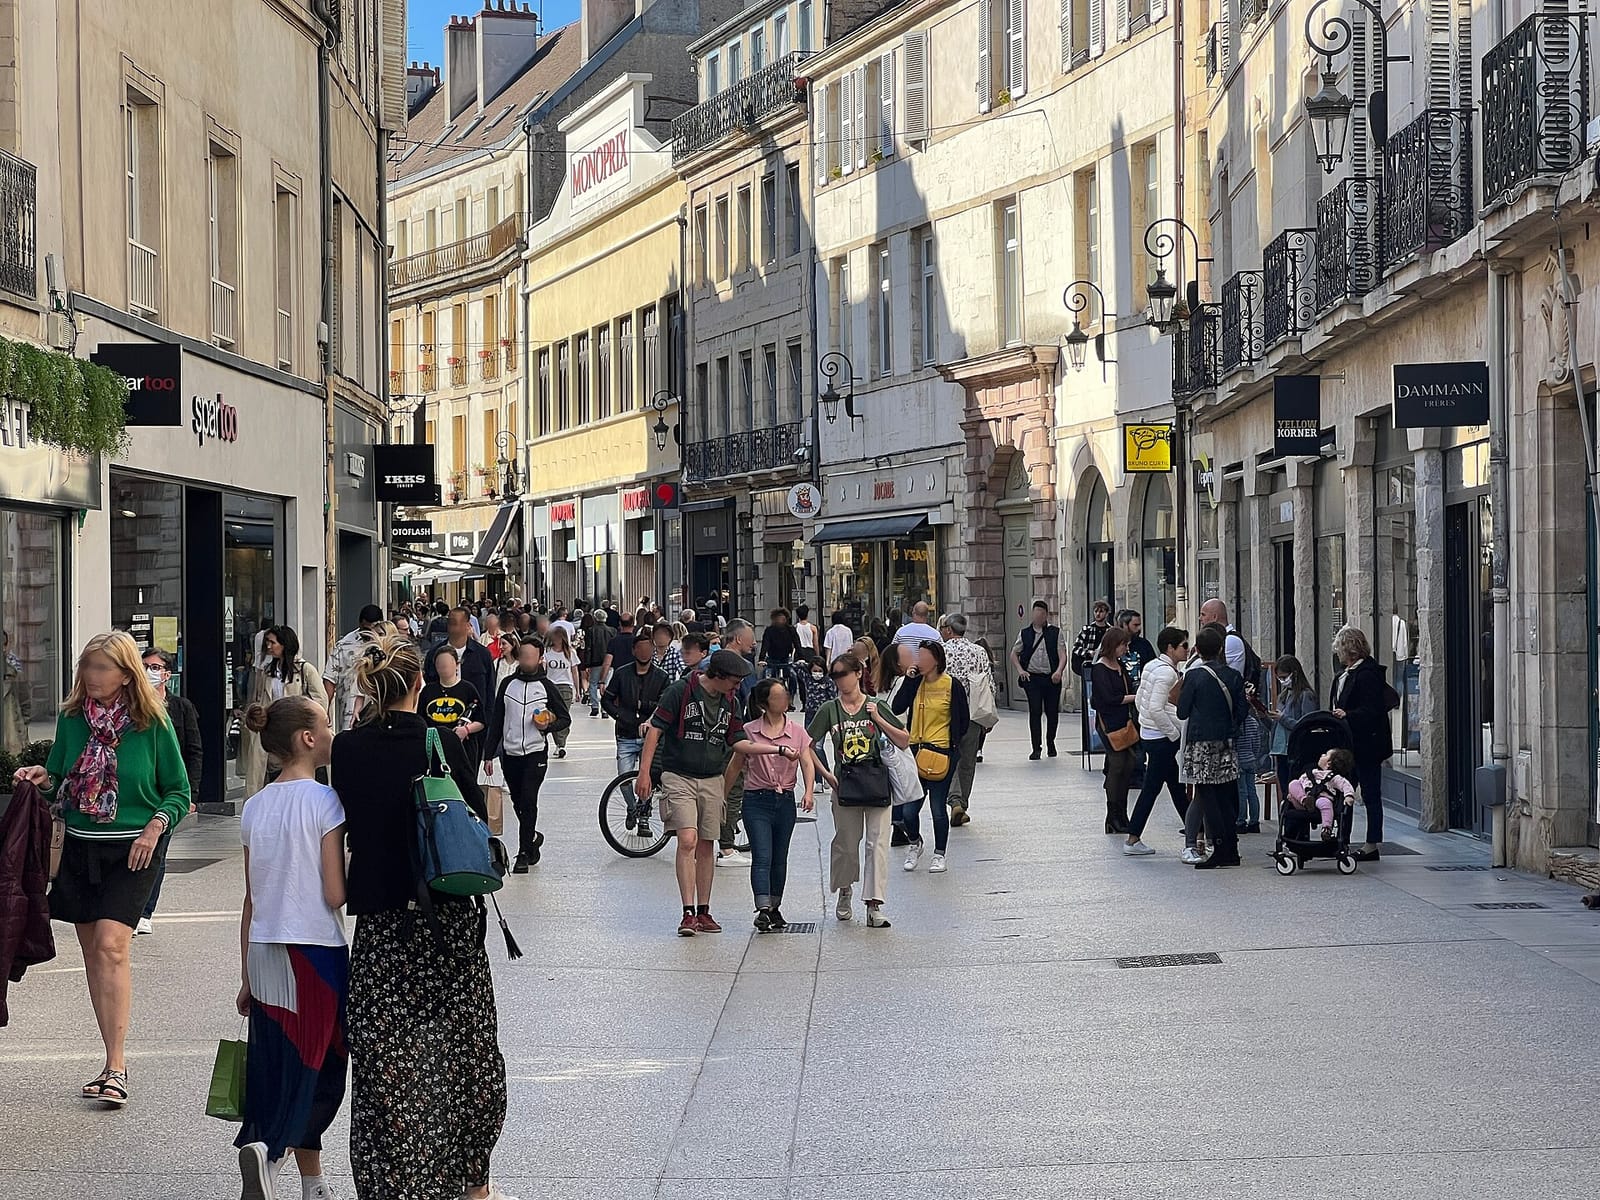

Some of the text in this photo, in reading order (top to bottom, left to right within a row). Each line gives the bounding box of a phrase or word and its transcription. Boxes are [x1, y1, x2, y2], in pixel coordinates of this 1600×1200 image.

[572, 128, 628, 198] MONOPRIX
[1397, 382, 1484, 399] DAMMANN
[191, 392, 238, 448] spartoo
[1277, 419, 1318, 429] YELLOW
[1277, 428, 1318, 438] KORNER
[384, 475, 425, 484] IKKS
[391, 528, 431, 536] OTOFLASH
[548, 659, 568, 670] Oh.
